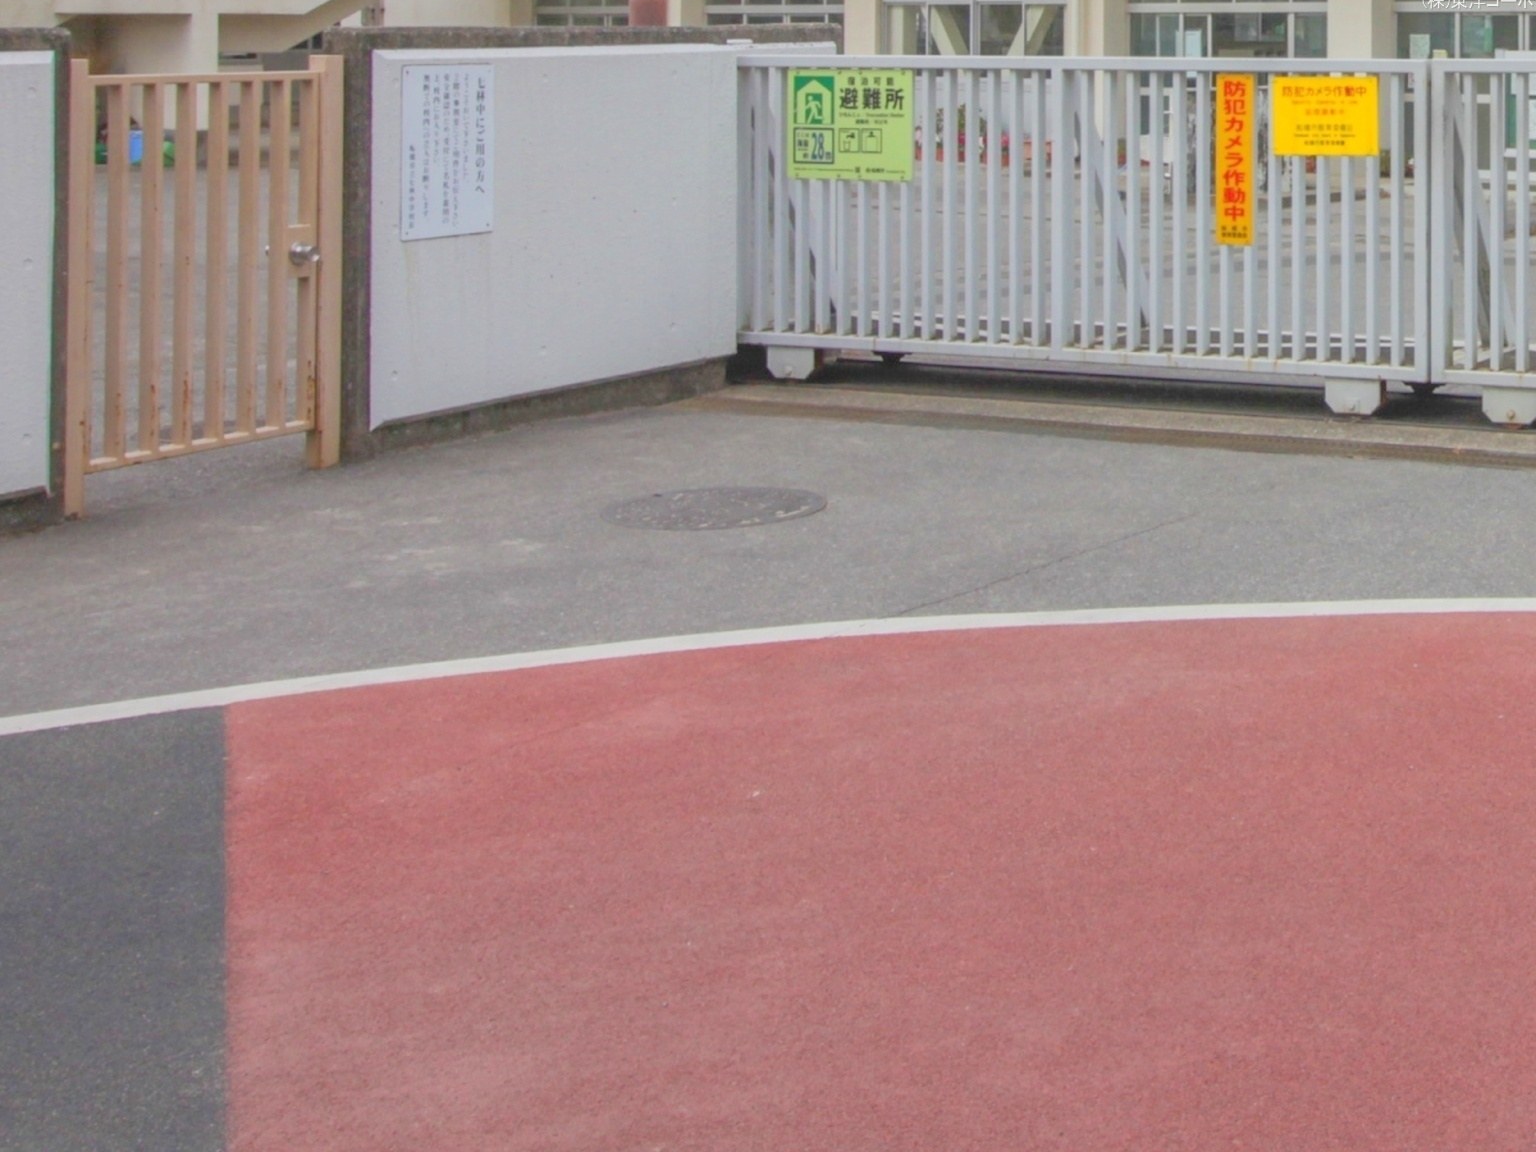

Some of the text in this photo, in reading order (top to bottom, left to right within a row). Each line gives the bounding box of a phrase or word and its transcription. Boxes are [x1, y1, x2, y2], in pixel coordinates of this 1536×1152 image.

[839, 87, 905, 110] 避難所
[1282, 85, 1367, 98] 防犯カメラ作動中
[475, 78, 486, 194] 七林中にご用の方へ
[811, 132, 825, 160] 28
[1223, 80, 1247, 222] 防犯カメラ作動中
